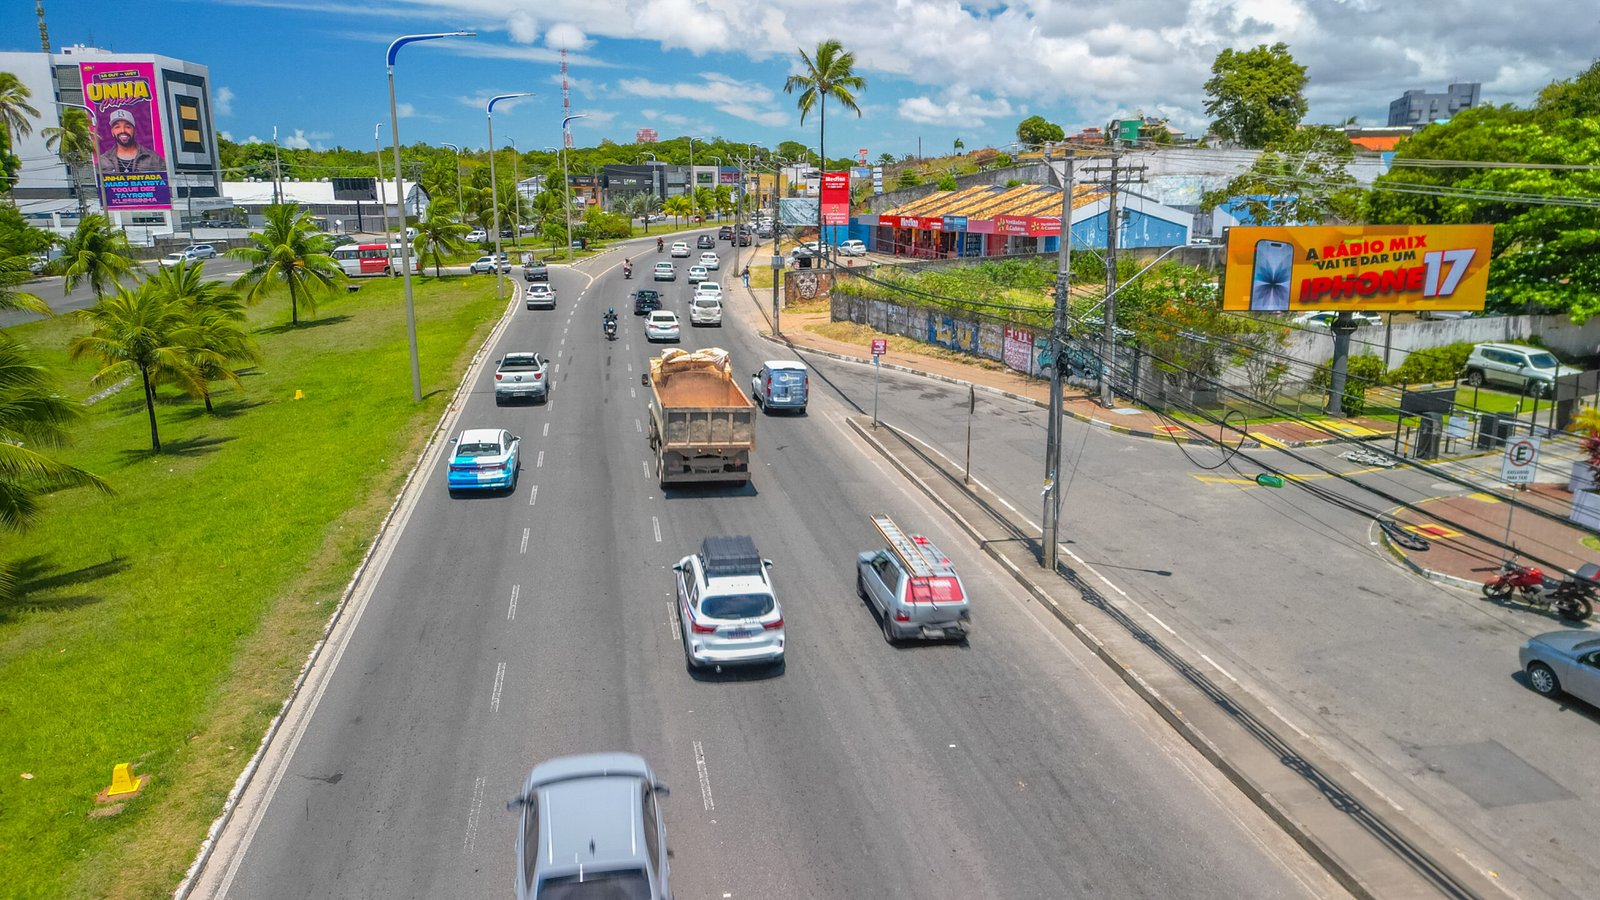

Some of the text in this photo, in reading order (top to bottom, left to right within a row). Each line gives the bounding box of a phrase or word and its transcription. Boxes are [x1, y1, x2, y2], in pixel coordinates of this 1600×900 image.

[88, 81, 149, 101] UNHA
[1306, 235, 1427, 261] A RÁDIO MIX
[1316, 250, 1416, 270] VAI TE DAR UM
[1299, 248, 1476, 303] IPHONE 17
[1515, 446, 1527, 461] E
